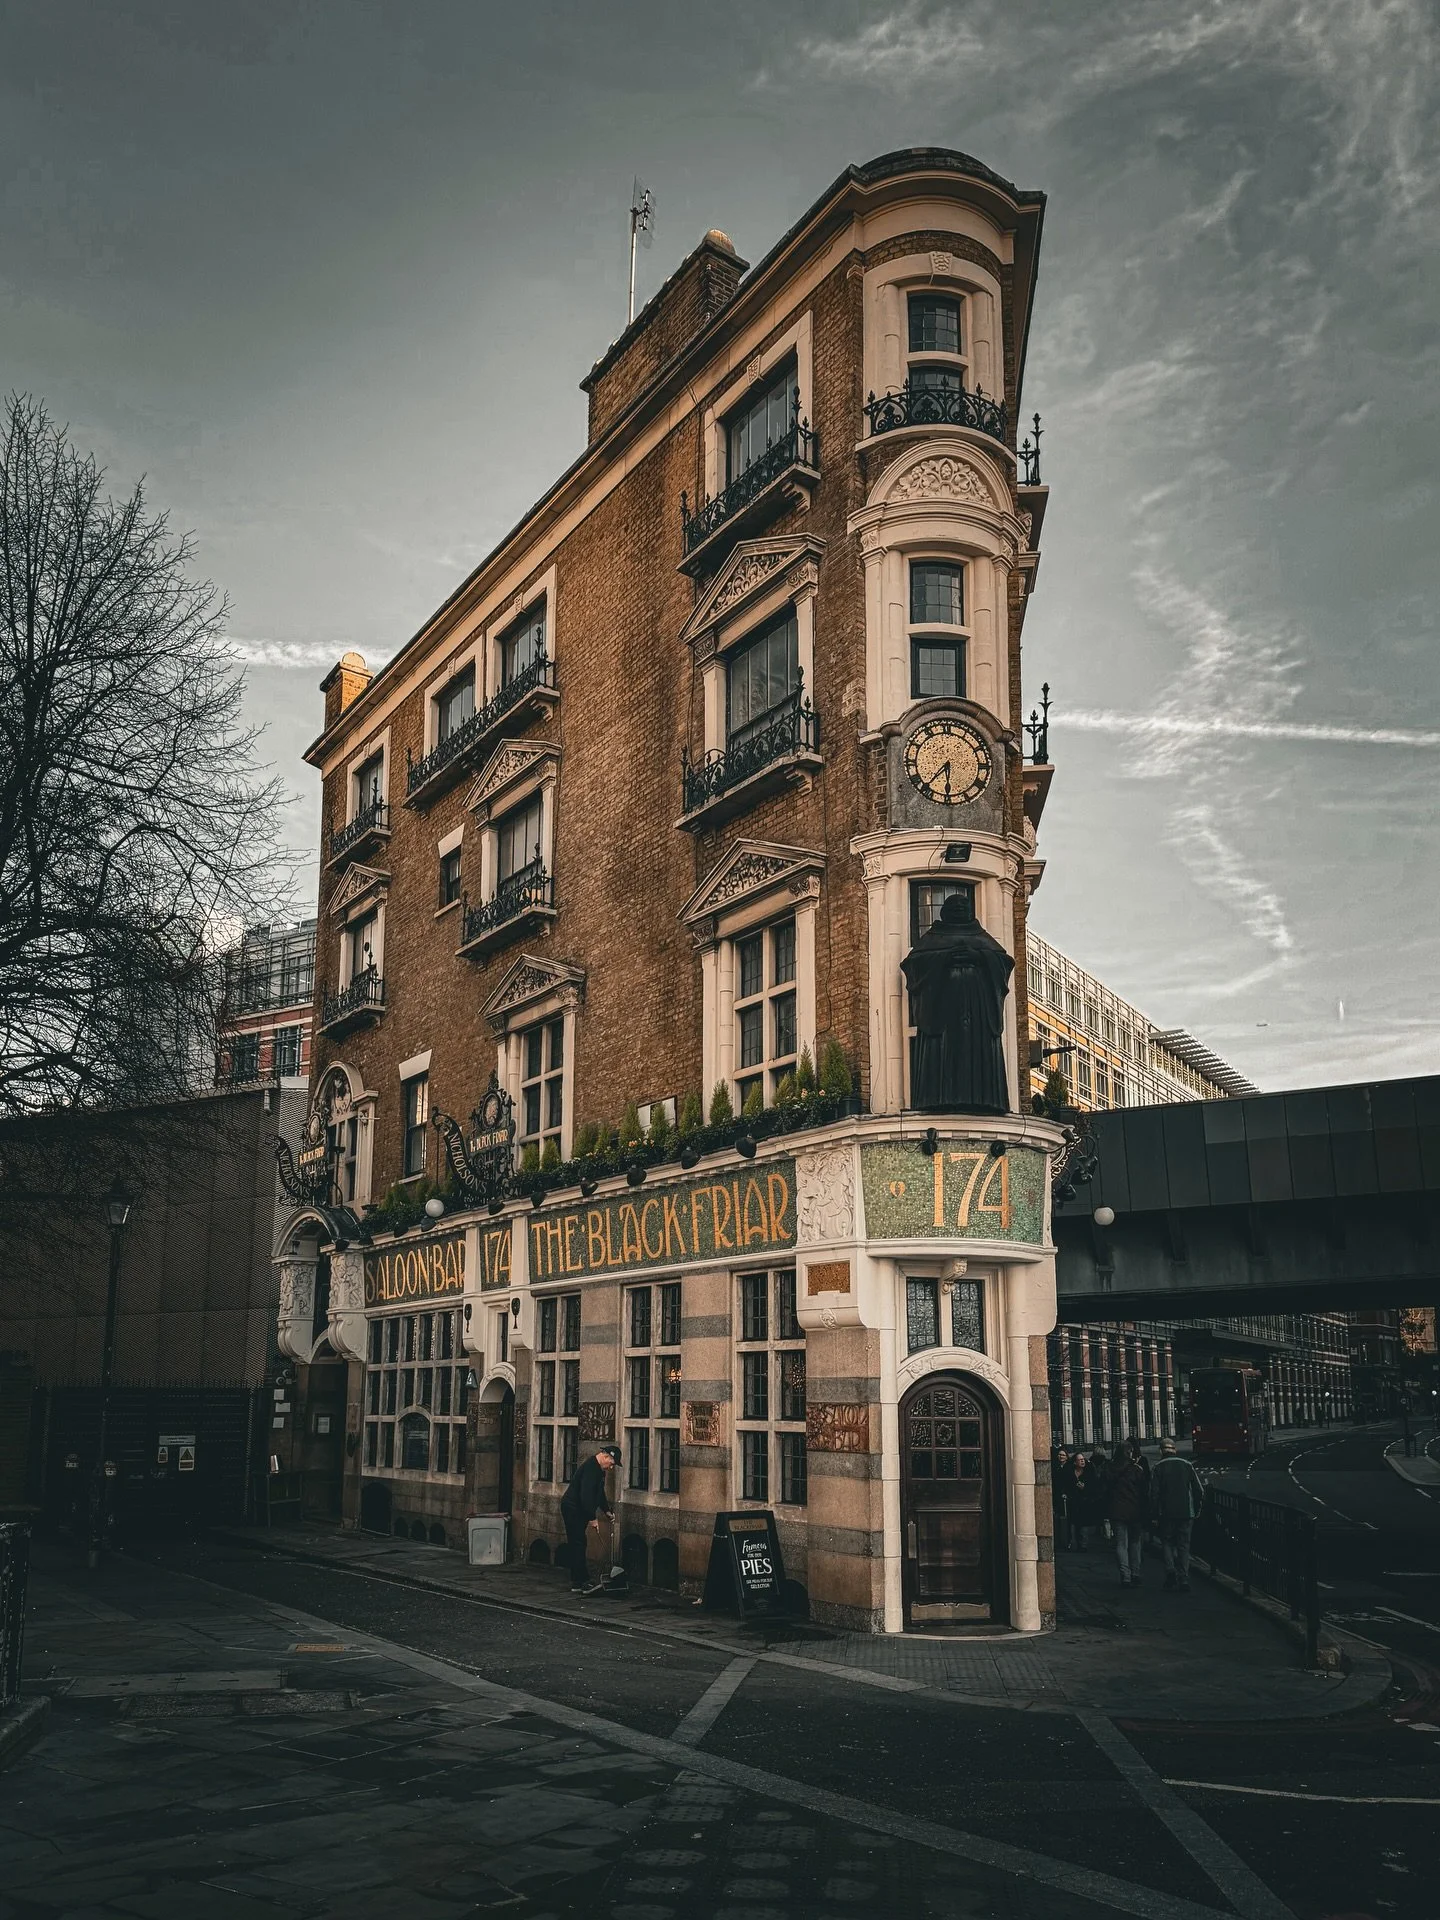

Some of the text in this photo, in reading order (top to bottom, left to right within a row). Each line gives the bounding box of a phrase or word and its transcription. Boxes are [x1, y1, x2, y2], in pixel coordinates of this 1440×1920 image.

[932, 1152, 1010, 1229] 174
[531, 1173, 793, 1276] THE BLACK FRIAR
[365, 1246, 430, 1303] SALOON
[484, 1229, 512, 1283] 174
[741, 1558, 773, 1576] PIES
